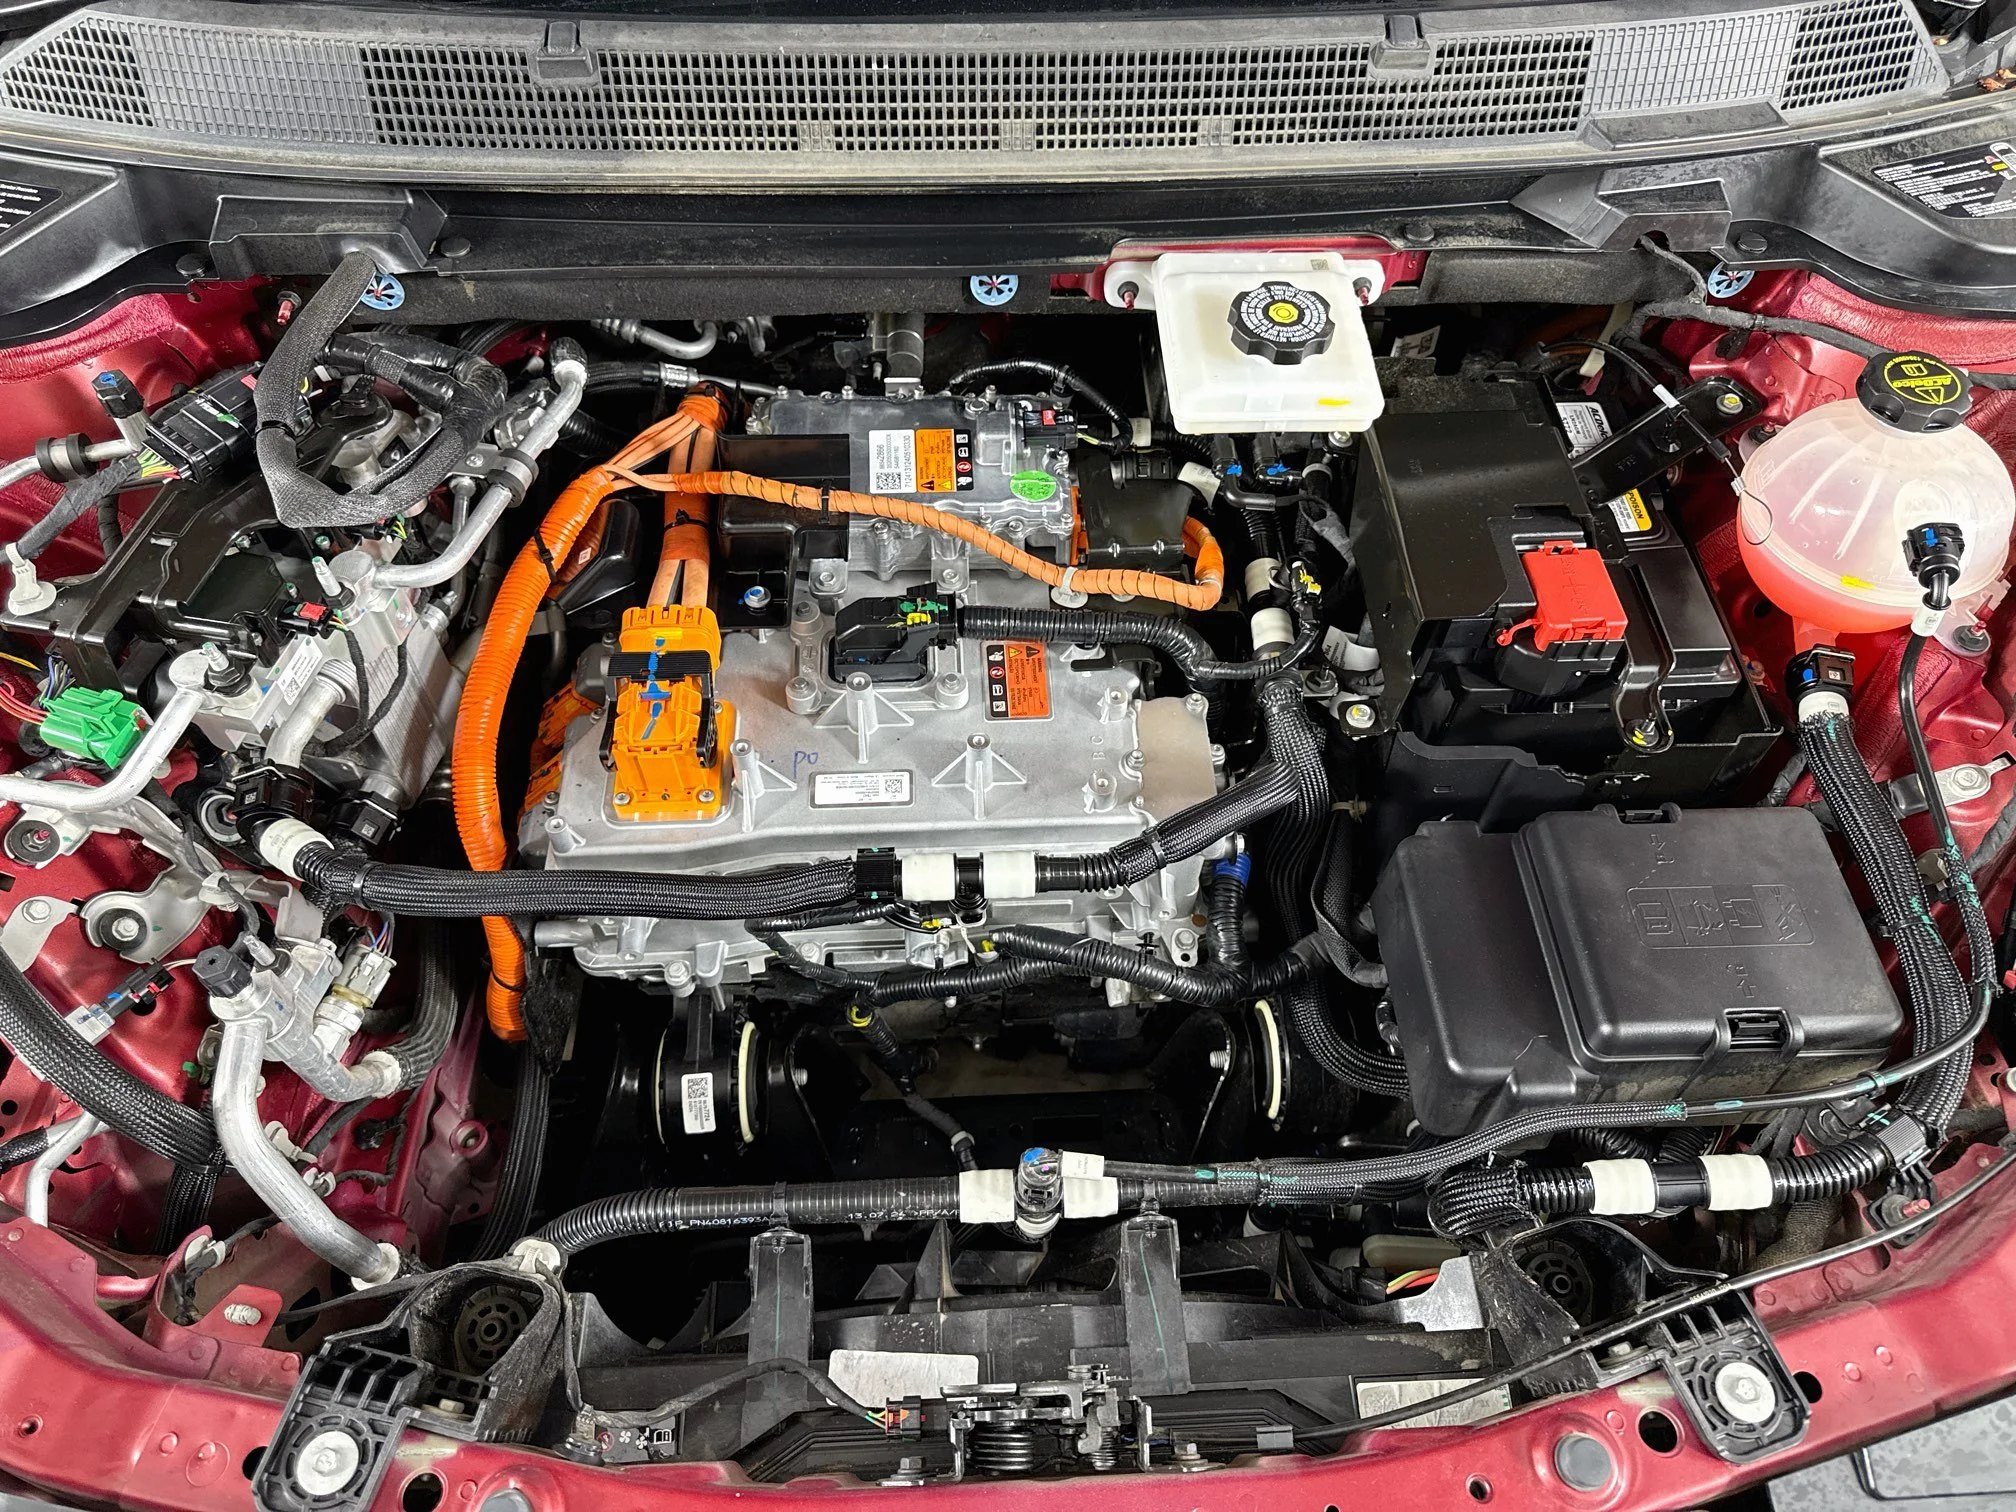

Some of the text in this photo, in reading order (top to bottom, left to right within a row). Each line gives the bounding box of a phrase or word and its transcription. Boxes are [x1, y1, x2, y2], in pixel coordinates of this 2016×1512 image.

[1892, 377, 1952, 388] ACDelco
[1589, 406, 1609, 440] ACDelc
[1628, 491, 1644, 519] POISON
